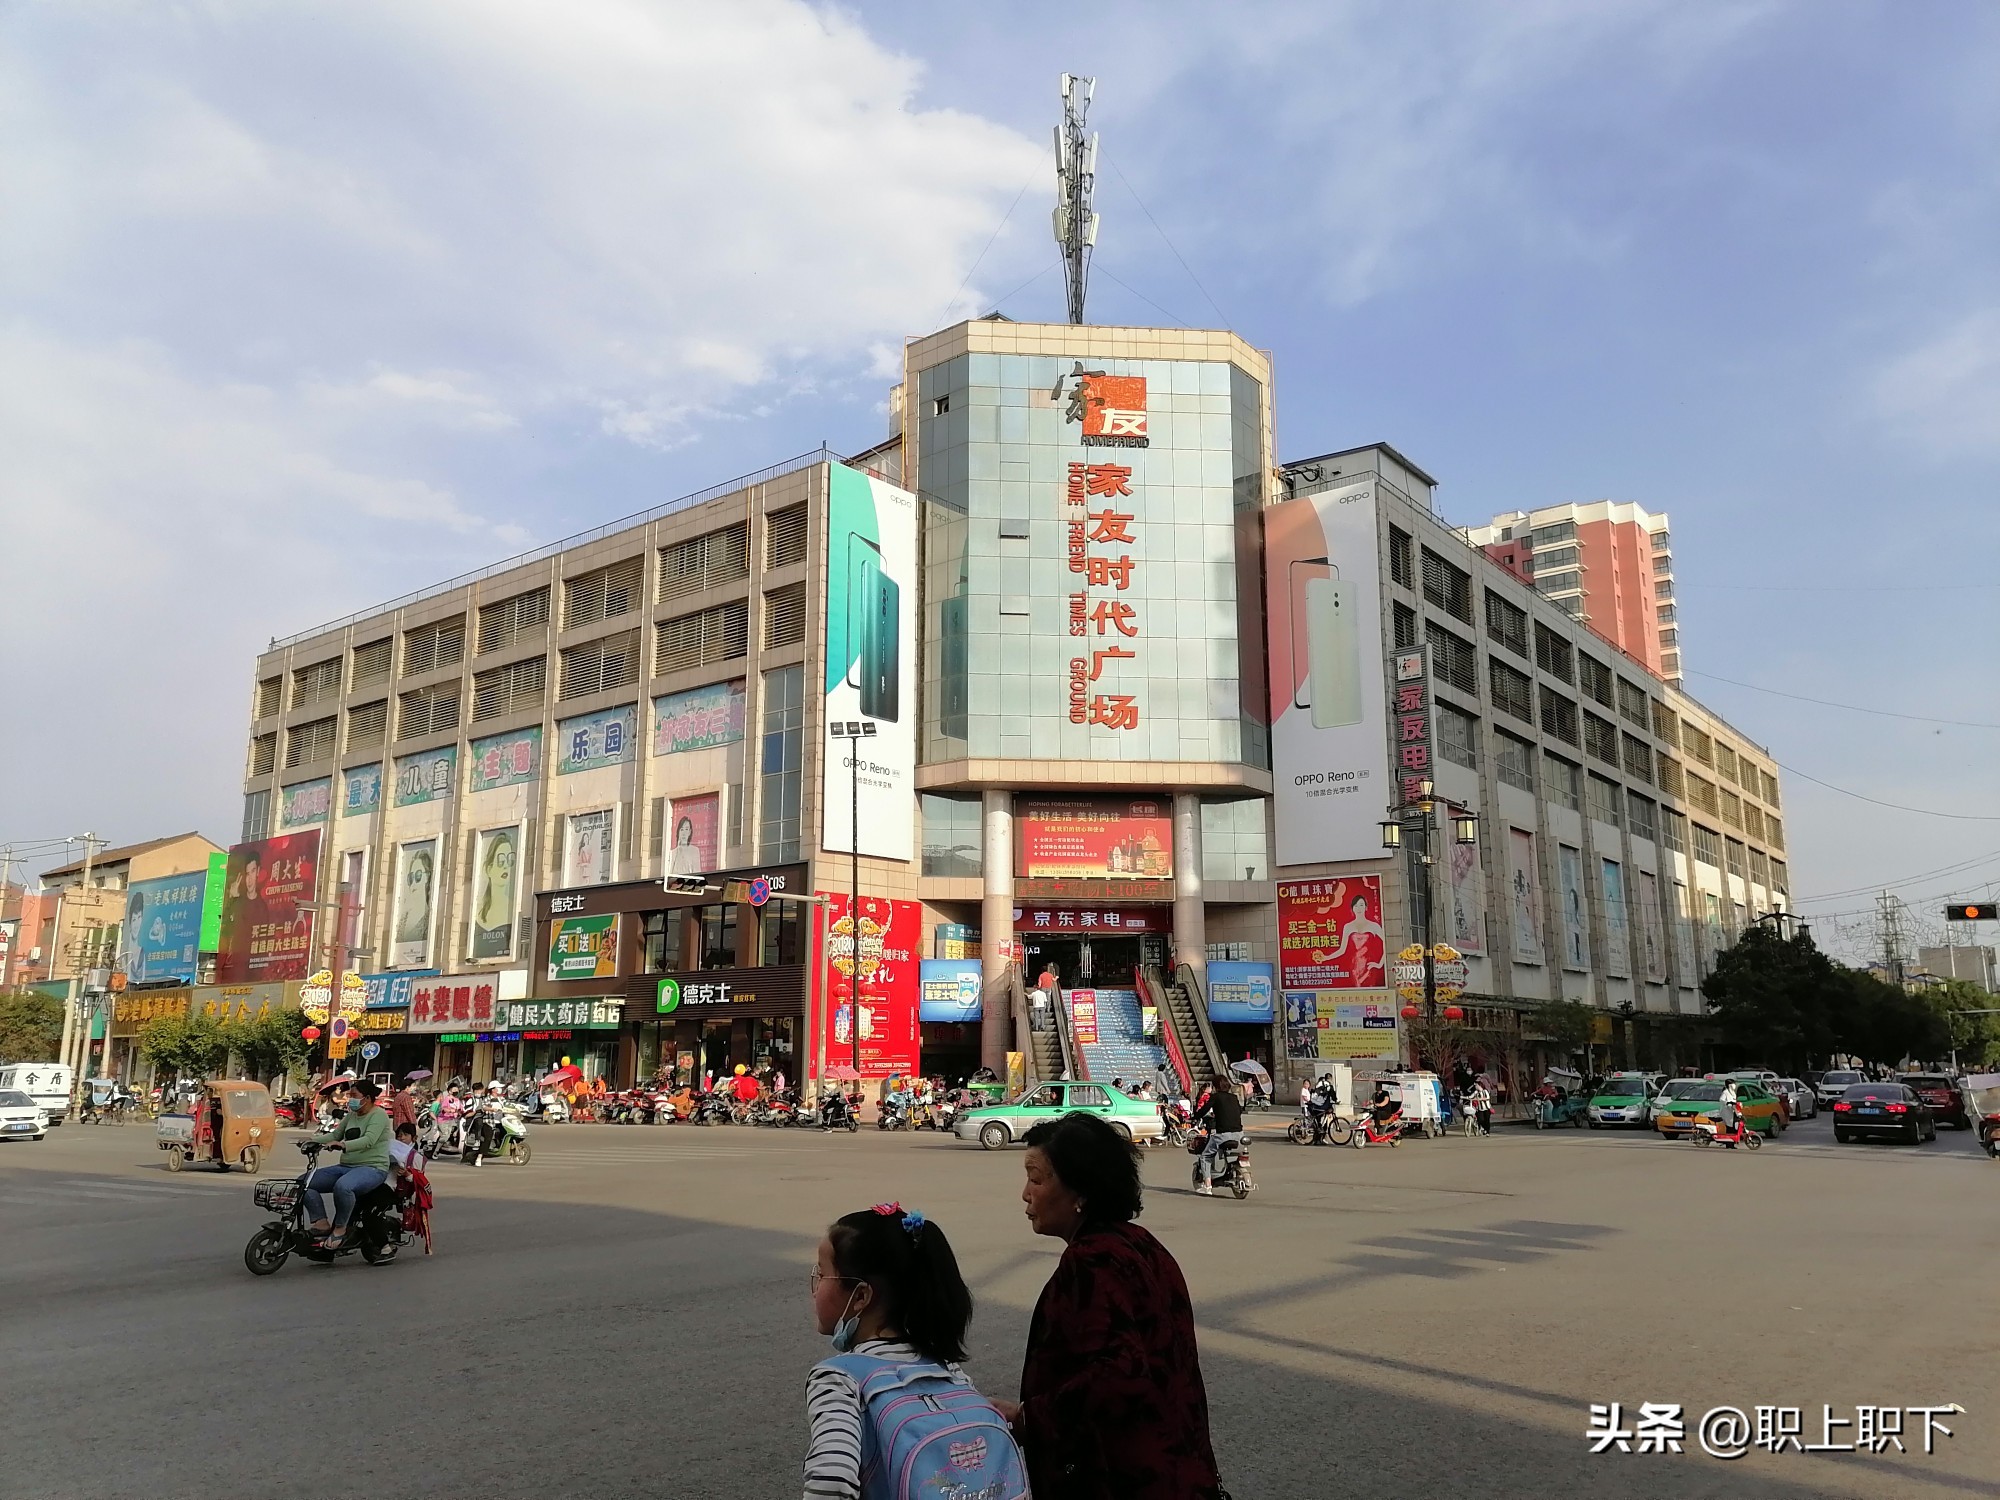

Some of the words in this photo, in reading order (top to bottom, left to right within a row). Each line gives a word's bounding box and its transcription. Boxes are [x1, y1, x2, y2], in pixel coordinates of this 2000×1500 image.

[1081, 434, 1150, 449] HOMEFRIEND
[1068, 462, 1086, 506] HOME
[1068, 520, 1087, 574] FRIEND
[1087, 462, 1139, 730] 家友时代广场
[1069, 591, 1087, 637] TIMES
[1069, 657, 1088, 724] GROUND
[570, 719, 623, 763] 乐园
[484, 740, 531, 780] 主题
[869, 761, 891, 776] Reno
[406, 758, 450, 796] 儿童
[1294, 772, 1324, 787] OPPO
[1327, 769, 1355, 784] Reno
[349, 774, 383, 809] 最大
[1029, 810, 1072, 822] 美好生活
[1077, 811, 1121, 823] 美好向往
[270, 856, 302, 882] 周大生
[551, 895, 585, 913] 德克士
[251, 921, 292, 939] 买三金一钻
[1033, 911, 1121, 927] 京东家电
[1288, 918, 1337, 935] 买三金一钻
[482, 931, 505, 940] BOLON
[558, 932, 601, 954] 买1送1
[1282, 934, 1341, 950] 就选龙凤珠宝
[1395, 965, 1426, 981] 2020
[682, 982, 731, 1004] 德克士
[509, 1002, 589, 1027] 健民大药房
[592, 1000, 621, 1024] 药店
